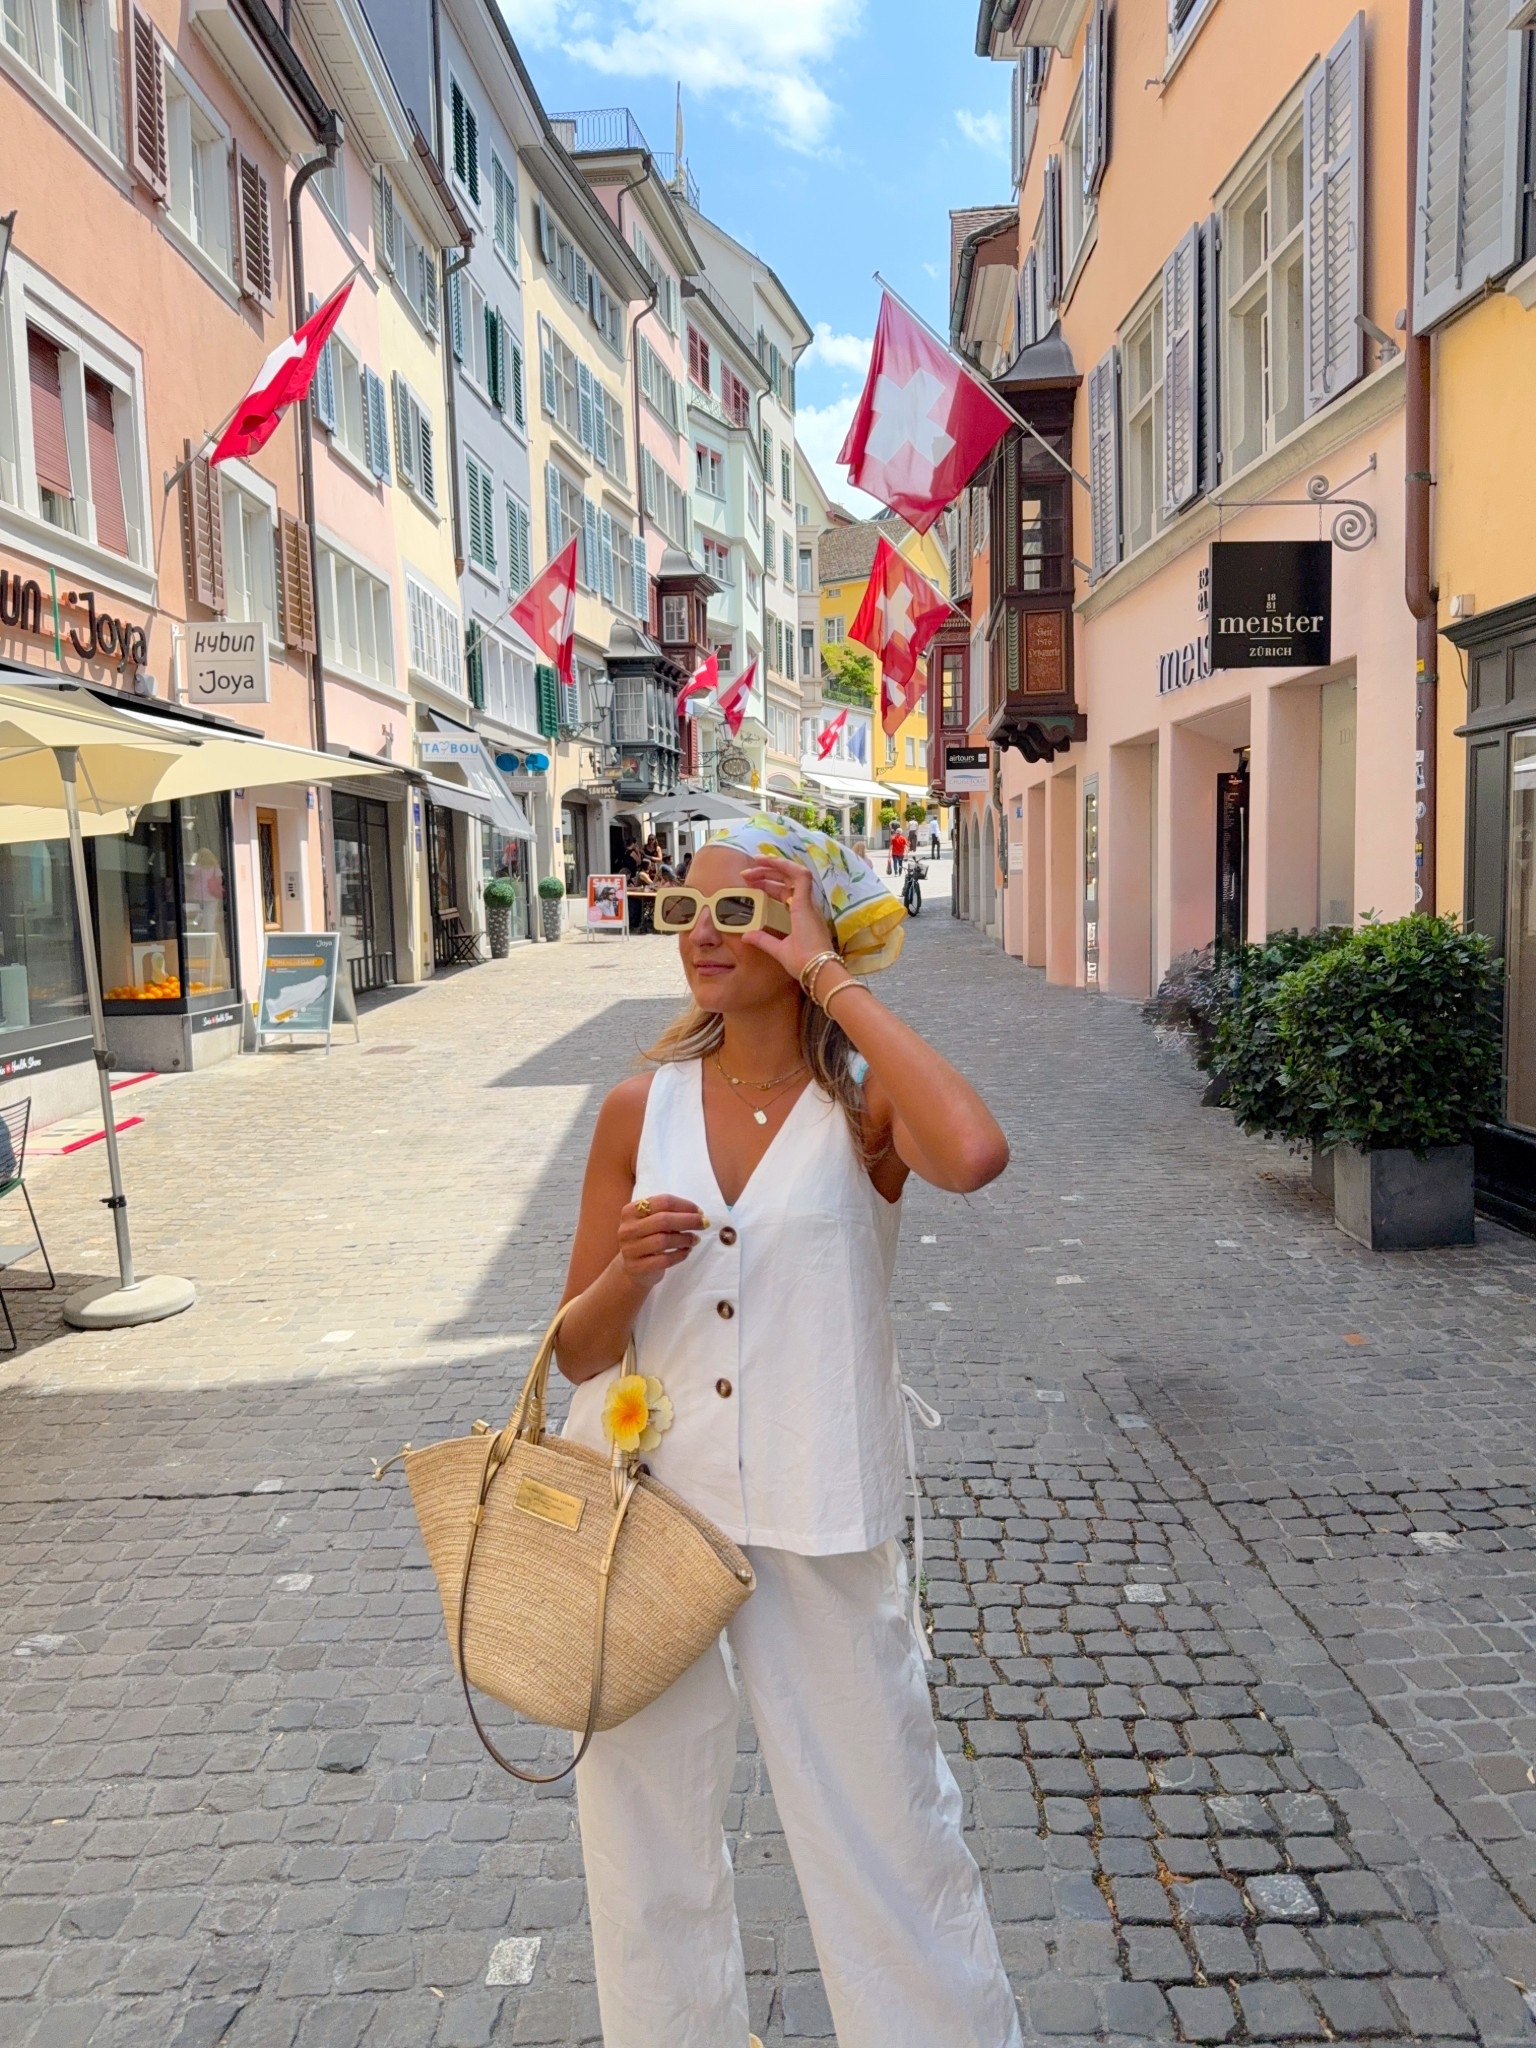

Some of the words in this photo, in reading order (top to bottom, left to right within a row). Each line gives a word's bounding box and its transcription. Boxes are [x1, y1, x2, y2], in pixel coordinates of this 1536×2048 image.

[1267, 593, 1277, 601] 18
[1266, 601, 1276, 610] 81
[1218, 612, 1324, 635] meister
[67, 591, 148, 674] Joya
[194, 631, 255, 653] kybun
[1249, 647, 1292, 657] ZÜRICH
[199, 669, 254, 695] Joya
[593, 878, 621, 888] SALE
[315, 940, 333, 948] Joya
